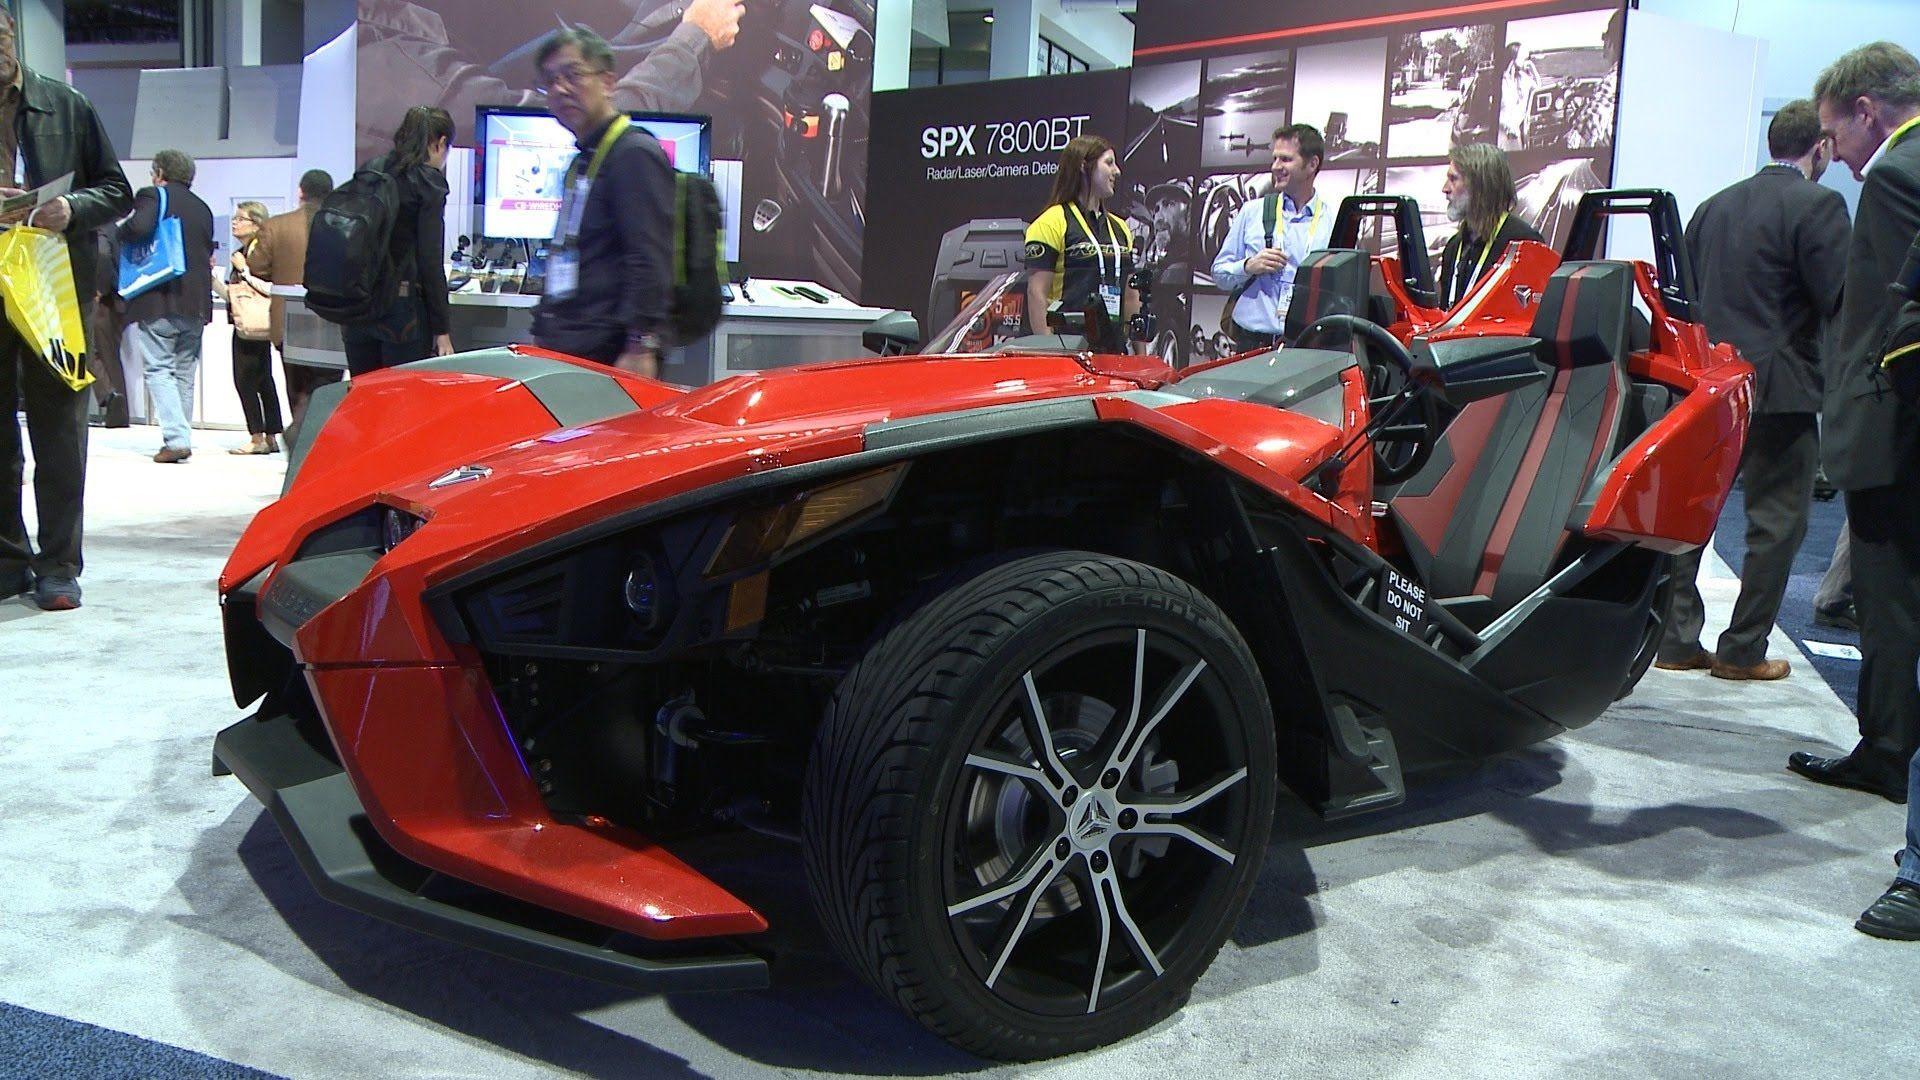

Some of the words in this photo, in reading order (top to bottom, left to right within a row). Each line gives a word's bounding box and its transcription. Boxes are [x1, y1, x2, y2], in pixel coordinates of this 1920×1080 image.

[921, 125, 977, 158] SPX
[985, 115, 1091, 155] 7800BT
[926, 161, 1029, 180] Radar/Laser/Camera
[1389, 571, 1426, 603] PLEASE
[1387, 590, 1402, 608] DO
[1403, 600, 1423, 620] NOT
[1395, 616, 1411, 632] SIT
